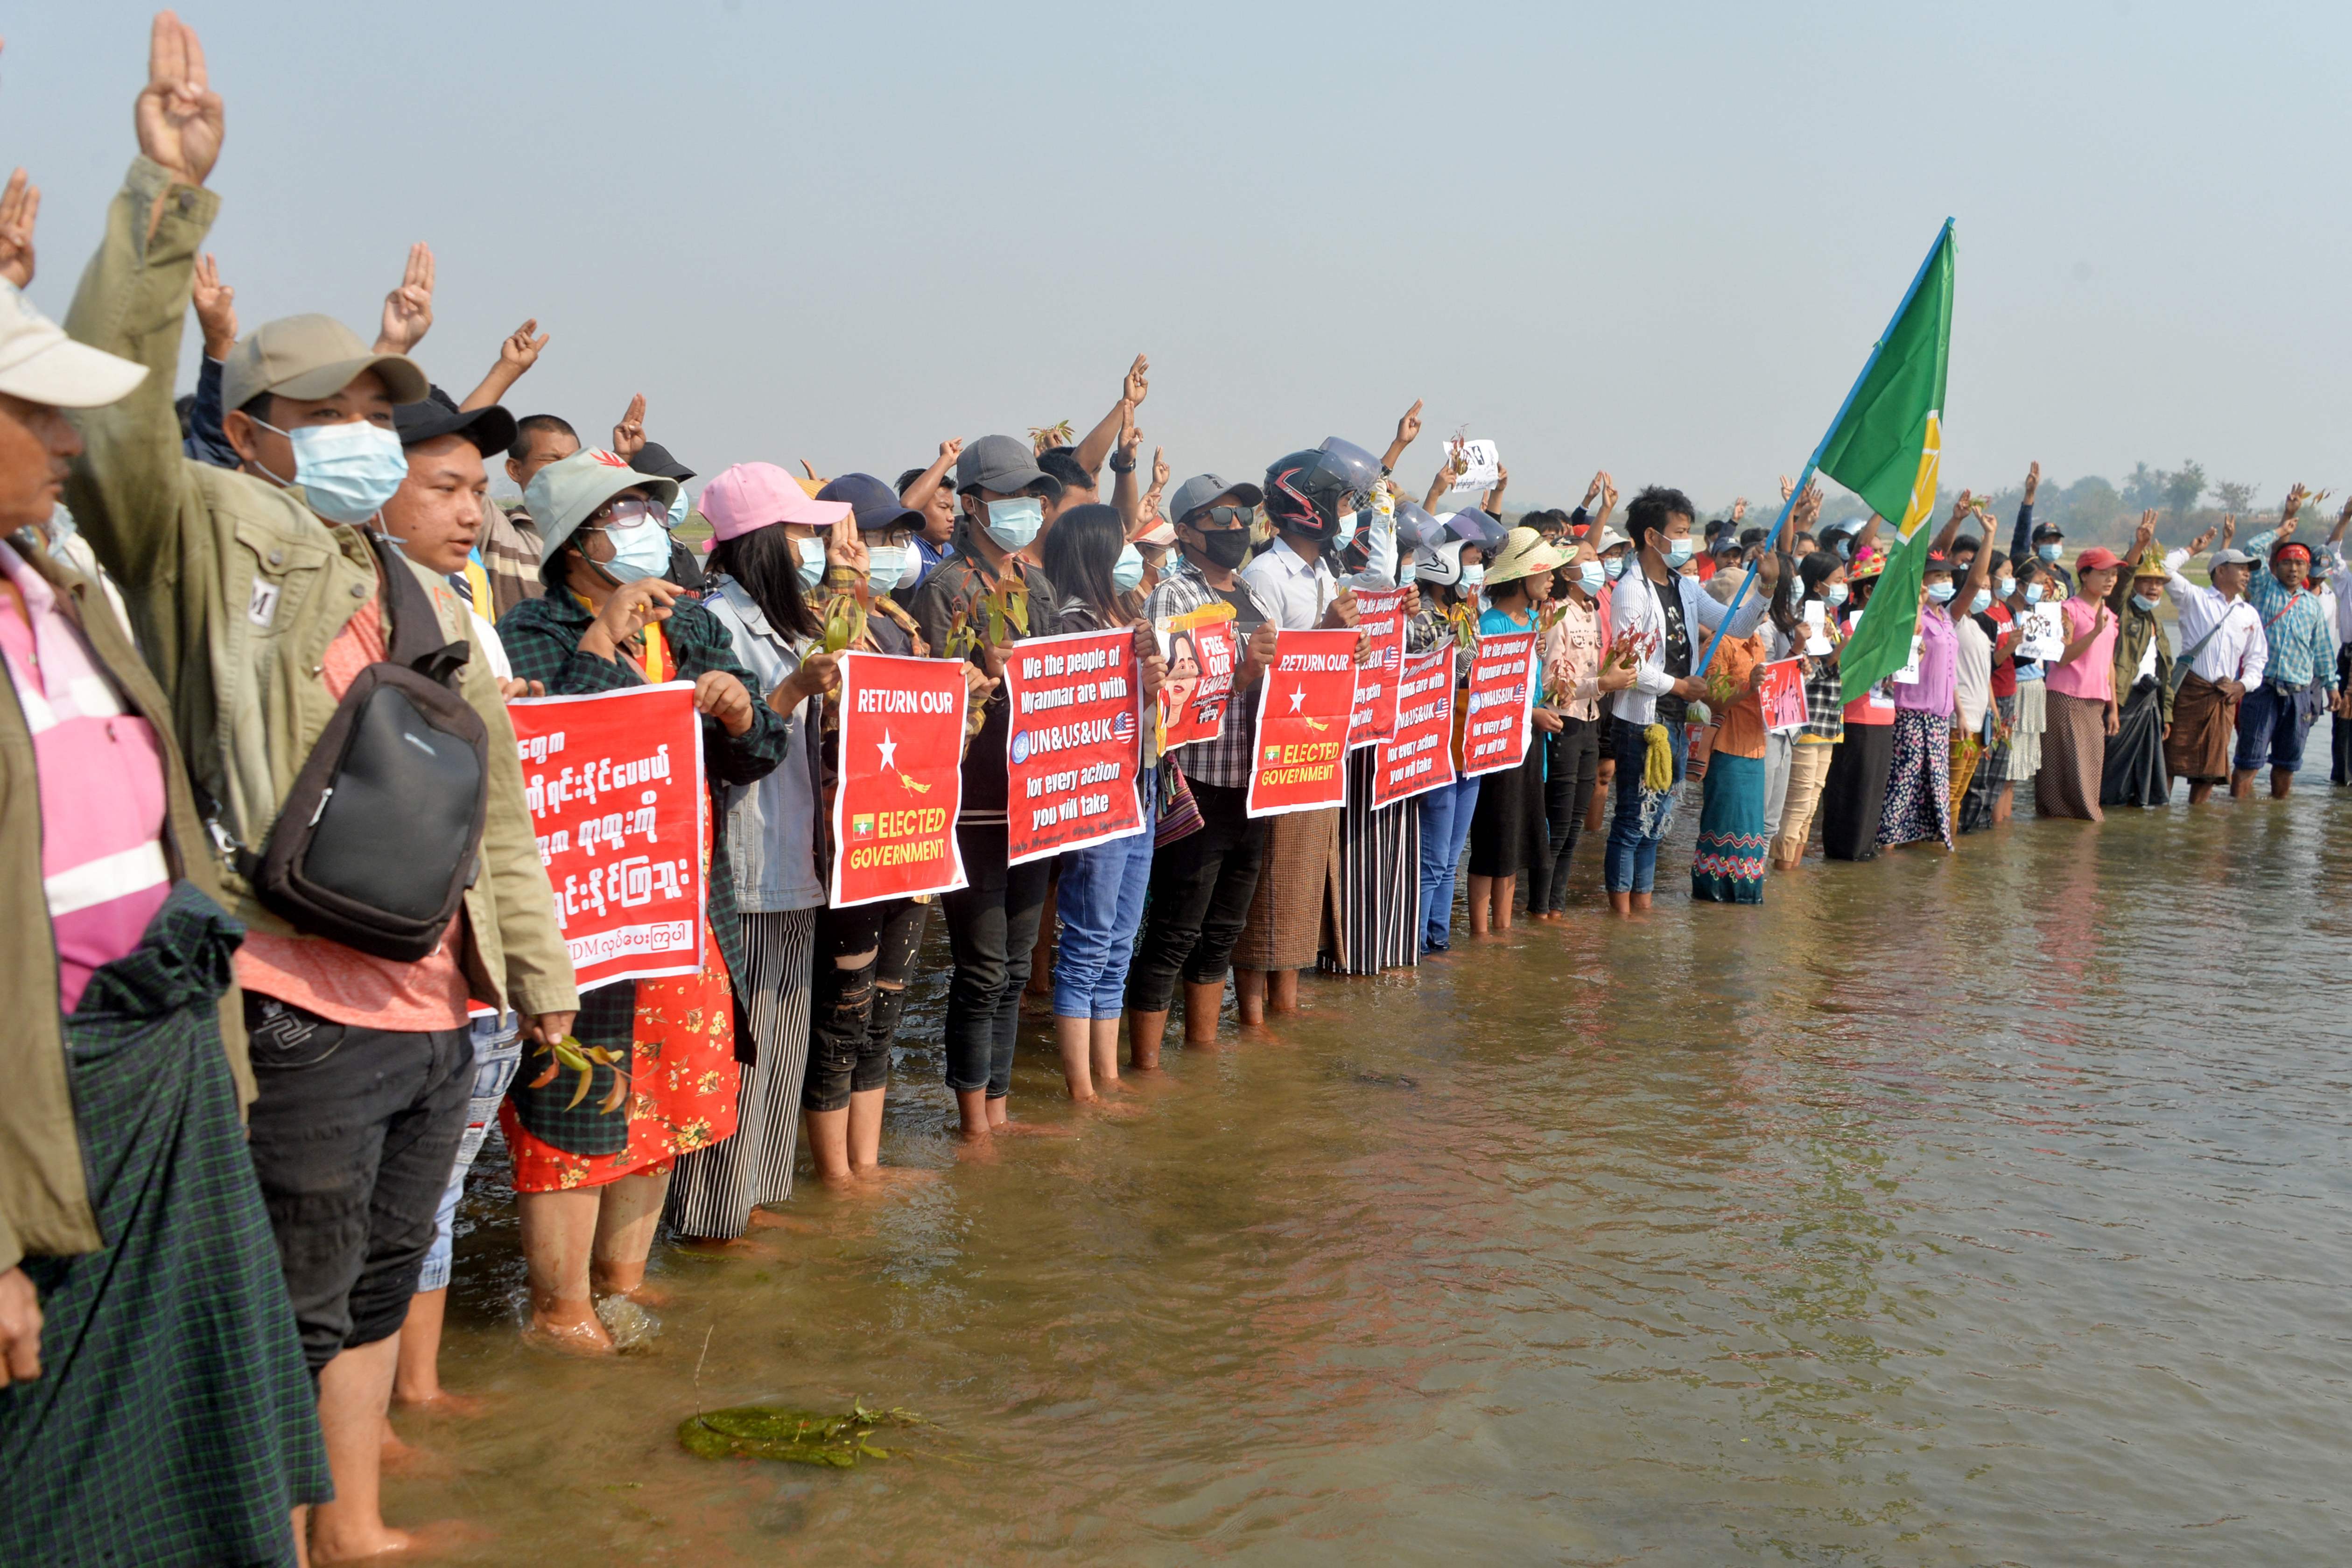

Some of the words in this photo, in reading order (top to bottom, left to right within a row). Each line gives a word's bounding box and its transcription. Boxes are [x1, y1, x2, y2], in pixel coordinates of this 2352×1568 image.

[1200, 635, 1229, 657] FREE
[1023, 657, 1042, 680] We
[1044, 654, 1064, 676] the
[1067, 648, 1106, 676] people
[1109, 645, 1120, 667] of
[1209, 654, 1230, 676] OUR
[1278, 654, 1326, 671] RETURN
[1327, 654, 1349, 671] OUR
[1021, 686, 1075, 714] Myanmar
[1077, 682, 1096, 703] are
[1099, 676, 1127, 699] with
[1416, 678, 1428, 694] are
[1429, 672, 1445, 690] with
[857, 689, 918, 713] RETURN
[920, 691, 953, 714] OUR
[1398, 702, 1435, 729] N&US&UK
[1029, 719, 1113, 755] UN&US&UK
[1388, 747, 1398, 763] for
[1399, 740, 1417, 759] every
[1417, 733, 1438, 752] action
[1284, 742, 1339, 764] ELECTED
[1026, 777, 1043, 799] for
[1045, 769, 1079, 794] every
[1080, 761, 1120, 786] action
[1262, 764, 1334, 786] GOVERNMENT
[1389, 767, 1404, 785] you
[1417, 757, 1432, 774] take
[878, 808, 946, 838] ELECTED
[1032, 806, 1058, 831] you
[1080, 793, 1109, 816] take
[850, 838, 944, 870] GOVERNMENT
